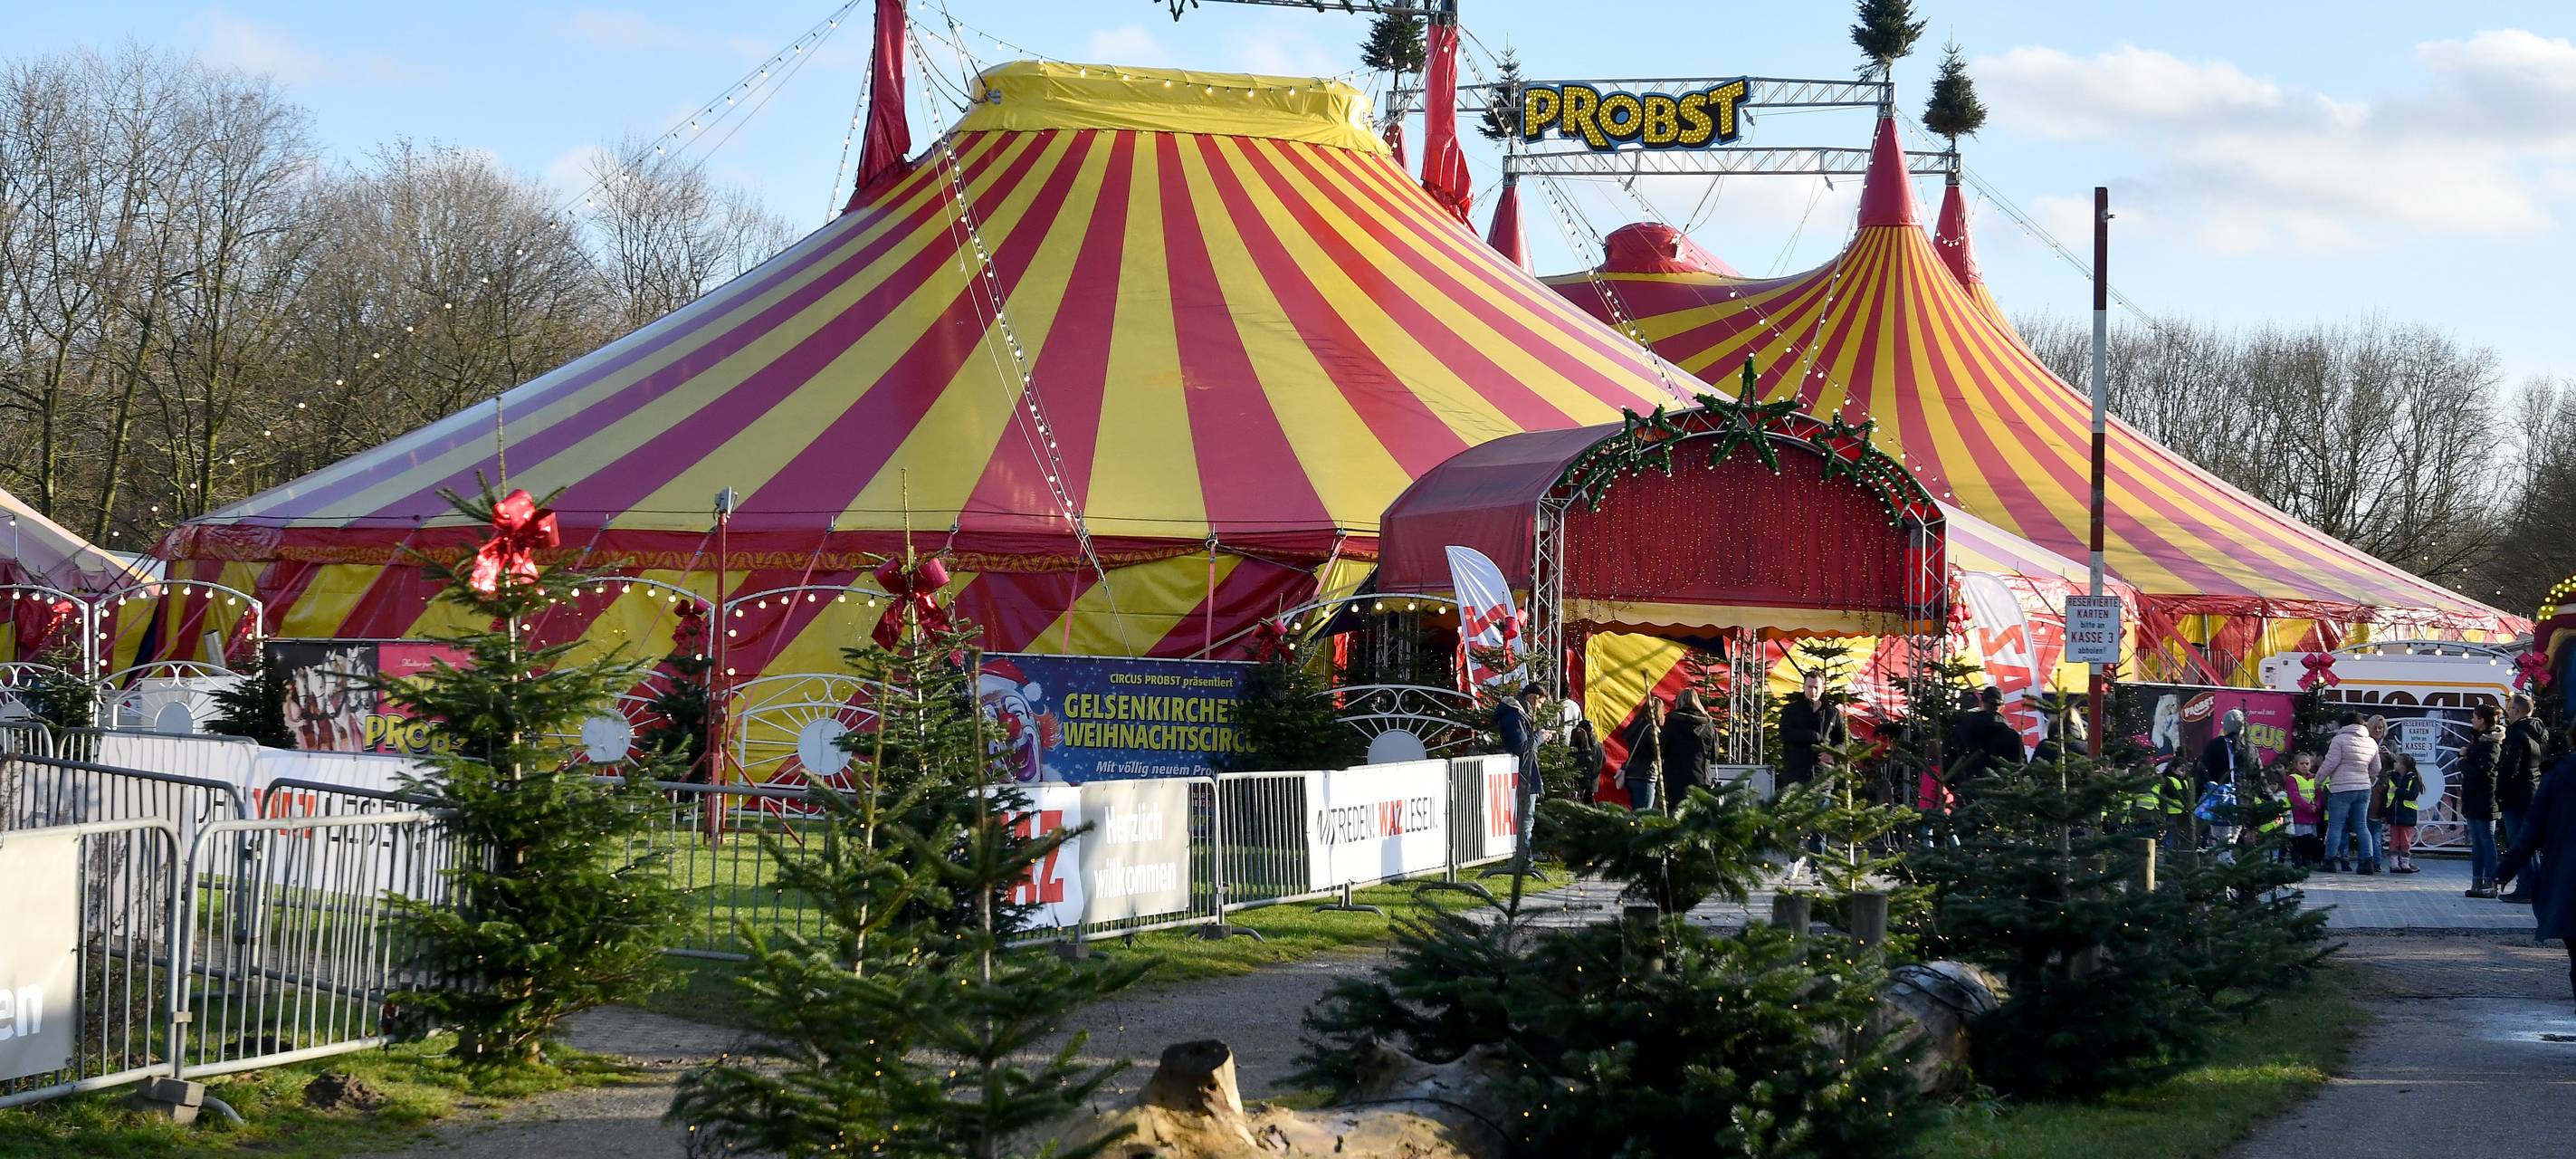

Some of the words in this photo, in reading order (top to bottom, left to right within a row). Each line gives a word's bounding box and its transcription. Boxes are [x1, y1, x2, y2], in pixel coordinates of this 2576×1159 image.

[1522, 77, 1751, 151] PROBST
[2067, 598, 2118, 608] RESERVIERTE
[2077, 608, 2109, 618] KARTEN
[2071, 631, 2104, 644] KASSE
[2108, 632, 2114, 644] 3
[1110, 674, 1142, 685] CIRCUS
[1144, 675, 1181, 686] PROBST
[1183, 676, 1234, 688] präsentiert
[2184, 695, 2214, 717] PROBST
[2405, 742, 2426, 751] KASSE
[2428, 742, 2433, 751] 3
[1096, 761, 1116, 773] Mit
[1117, 762, 1150, 776] völlig
[1151, 765, 1190, 776] neuem
[1104, 801, 1163, 845] Herzlich
[1379, 799, 1403, 837] WAZ
[1404, 795, 1438, 833] LESEN.
[1094, 857, 1178, 899] willkommen
